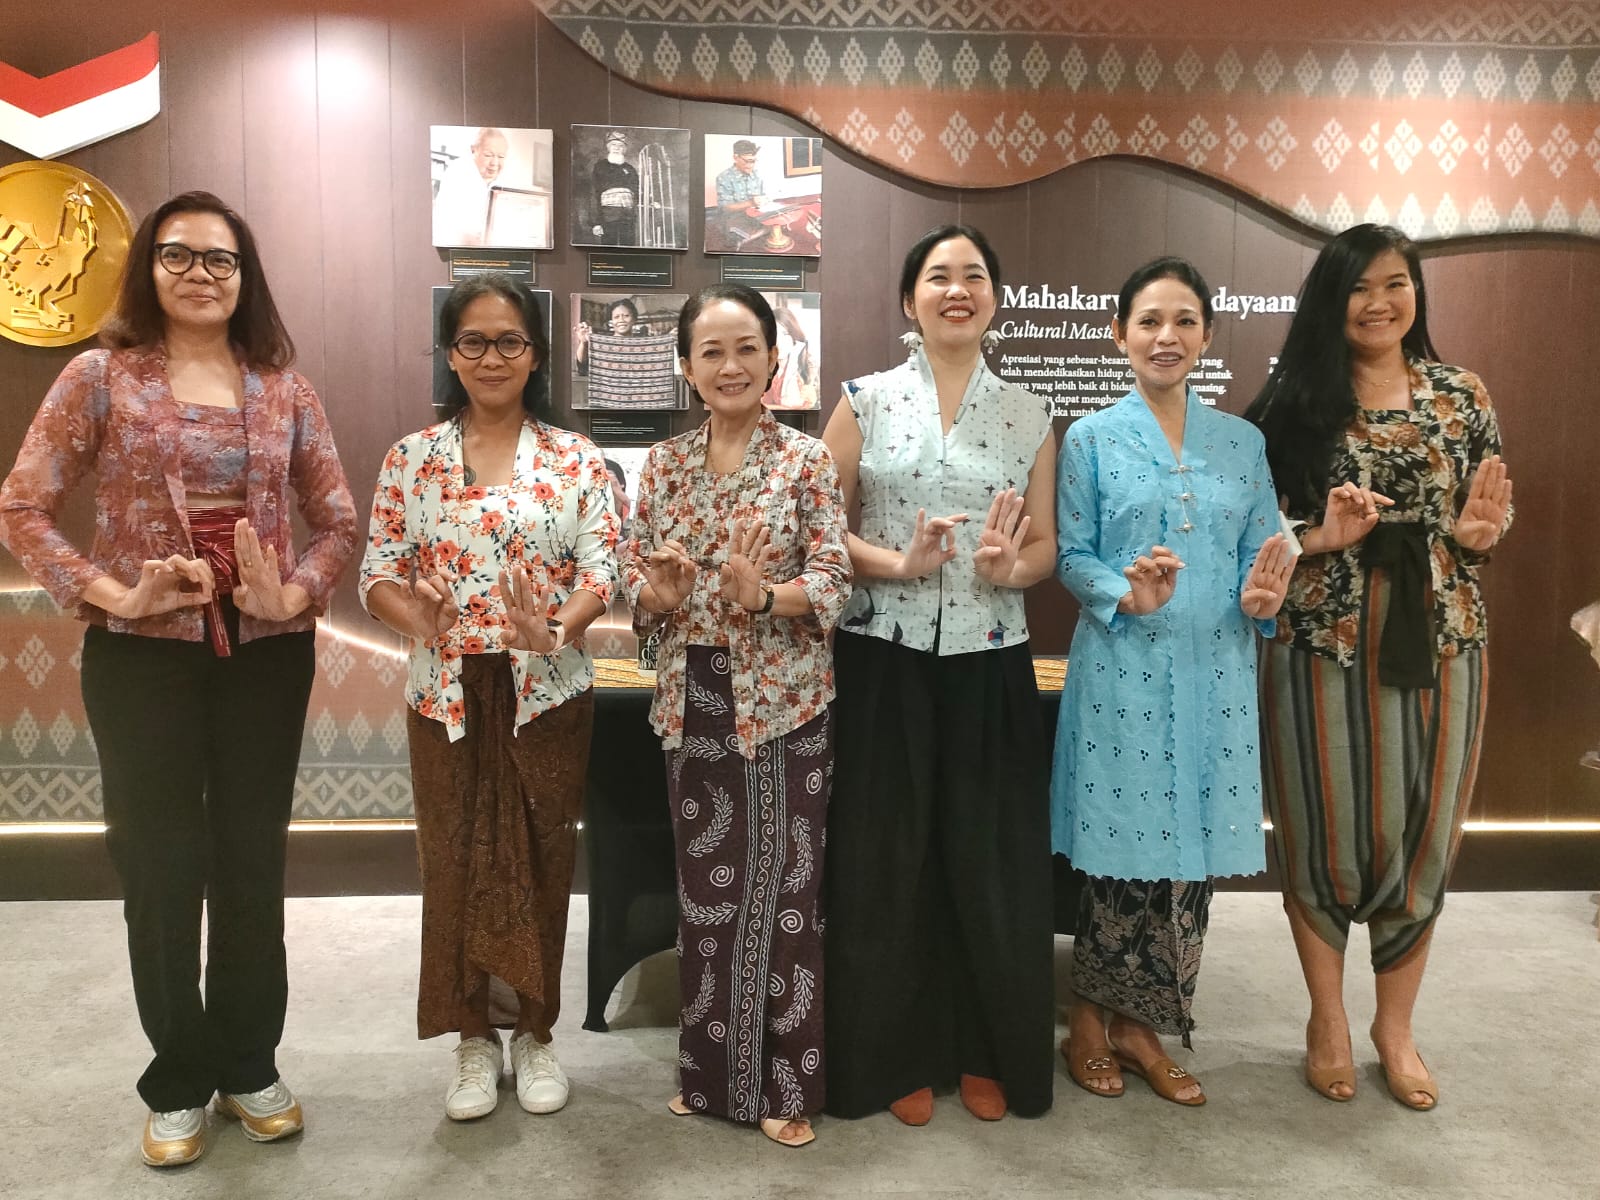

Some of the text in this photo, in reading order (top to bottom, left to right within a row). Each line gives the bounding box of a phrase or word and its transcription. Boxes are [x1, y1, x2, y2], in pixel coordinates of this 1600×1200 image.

[1001, 284, 1297, 320] Mahakary dayaan
[1001, 320, 1114, 339] Cultural Maste
[1000, 354, 1041, 365] Apresiasi
[1043, 356, 1065, 366] yang
[1066, 355, 1131, 365] sebesar-besarn
[1201, 358, 1223, 369] yang
[1000, 367, 1022, 377] telah
[1024, 368, 1095, 378] mendedikasikan
[1097, 367, 1124, 380] hidup
[1205, 369, 1233, 379] untuk
[1031, 382, 1053, 392] yang
[1054, 380, 1077, 391] lebih
[1078, 381, 1098, 391] baik
[1099, 381, 1109, 391] di
[1192, 383, 1227, 395] masing.
[1054, 394, 1080, 405] dapat
